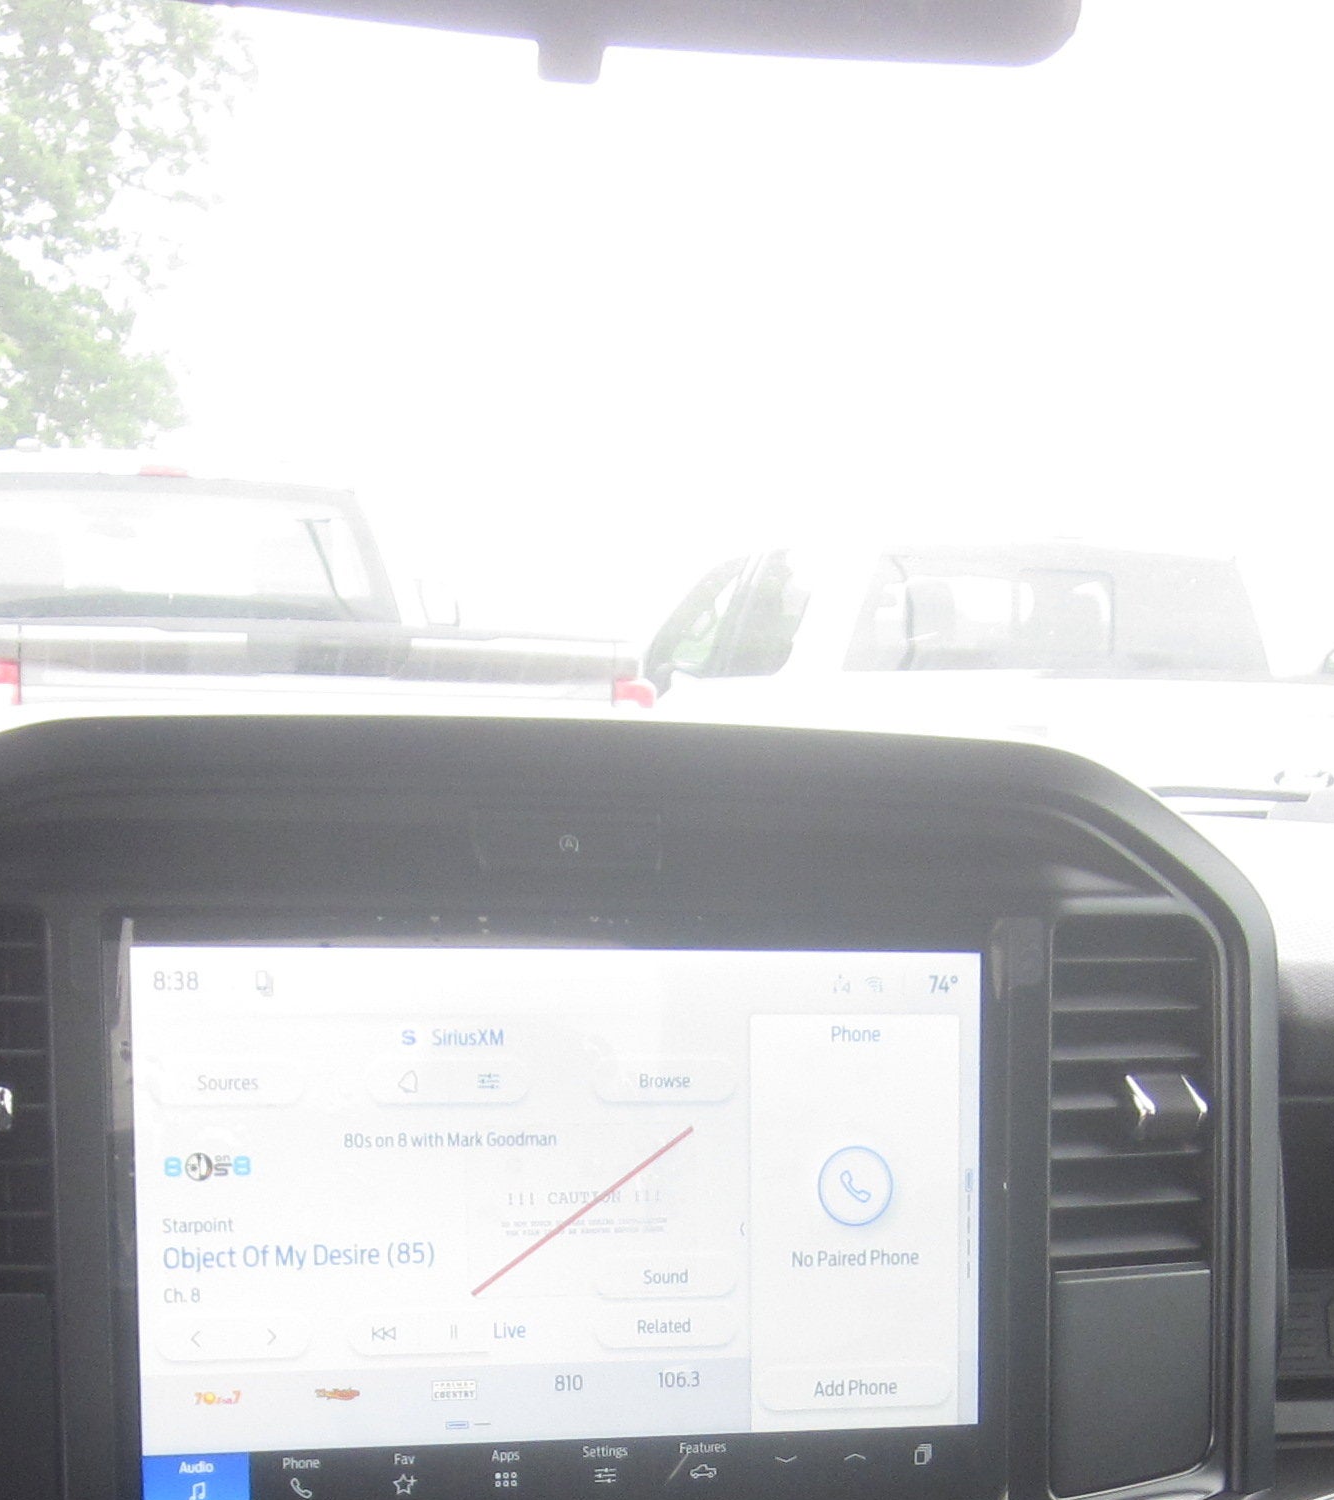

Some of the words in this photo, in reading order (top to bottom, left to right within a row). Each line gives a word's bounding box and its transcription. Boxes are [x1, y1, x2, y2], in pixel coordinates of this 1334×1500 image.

[153, 970, 199, 991] 8:38
[928, 974, 959, 994] 74°
[431, 1028, 505, 1046] SiriusXM
[831, 1025, 881, 1044] Phone
[197, 1074, 259, 1093] Sources
[639, 1073, 691, 1089] Browse
[343, 1132, 372, 1149] 80s
[375, 1135, 394, 1149] on
[397, 1132, 408, 1149] 8
[411, 1131, 444, 1149] with
[447, 1131, 484, 1148] Mark
[486, 1130, 558, 1148] Goodman
[547, 1189, 621, 1206] CAUTION
[162, 1217, 234, 1236] Starpoint
[163, 1246, 236, 1273] Object
[243, 1245, 270, 1268] Of
[275, 1244, 307, 1270] My
[313, 1243, 380, 1266] Desire
[387, 1241, 435, 1268] (85)
[791, 1251, 814, 1268] No
[817, 1250, 866, 1267] Paired
[870, 1249, 920, 1266] Phone
[643, 1269, 689, 1285] Sound
[163, 1288, 187, 1303] Ch.
[190, 1287, 201, 1303] 8
[493, 1322, 527, 1339] Live
[637, 1318, 692, 1335] Related
[554, 1374, 584, 1392] 810
[658, 1370, 700, 1388] 106.3
[813, 1379, 844, 1397] Add
[848, 1379, 898, 1395] Phone
[583, 1445, 628, 1459] Settings
[679, 1441, 727, 1454] Features
[282, 1457, 320, 1470] Phone
[393, 1453, 415, 1466] Fav
[491, 1450, 520, 1463] Apps
[178, 1461, 215, 1474] Audio
